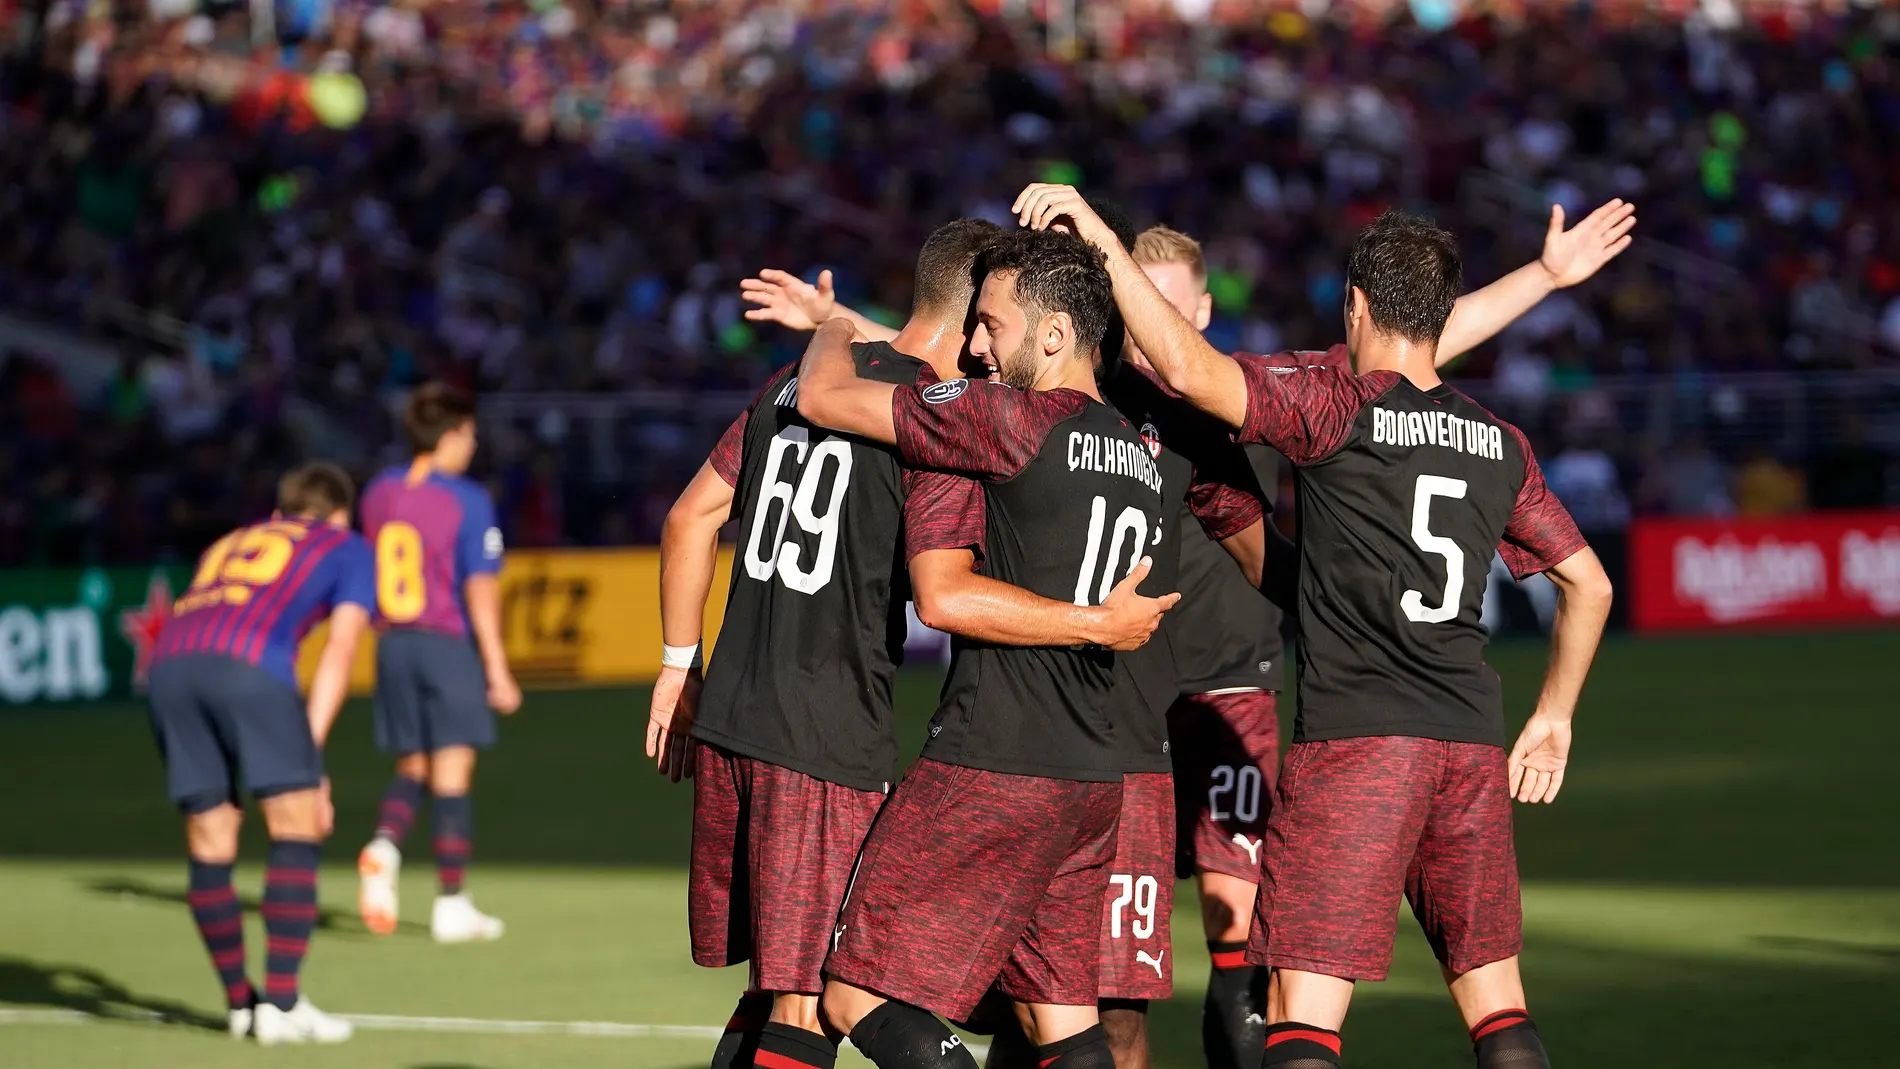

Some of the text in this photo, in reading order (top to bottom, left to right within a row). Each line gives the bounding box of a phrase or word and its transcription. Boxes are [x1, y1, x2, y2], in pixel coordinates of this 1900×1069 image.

[1372, 406, 1503, 460] BONAVENTURA
[744, 424, 853, 595] 69
[1073, 495, 1148, 607] 10
[1400, 474, 1468, 624] 5
[376, 520, 426, 622] 8
[1208, 764, 1262, 823] 20
[1109, 874, 1158, 939] 79
